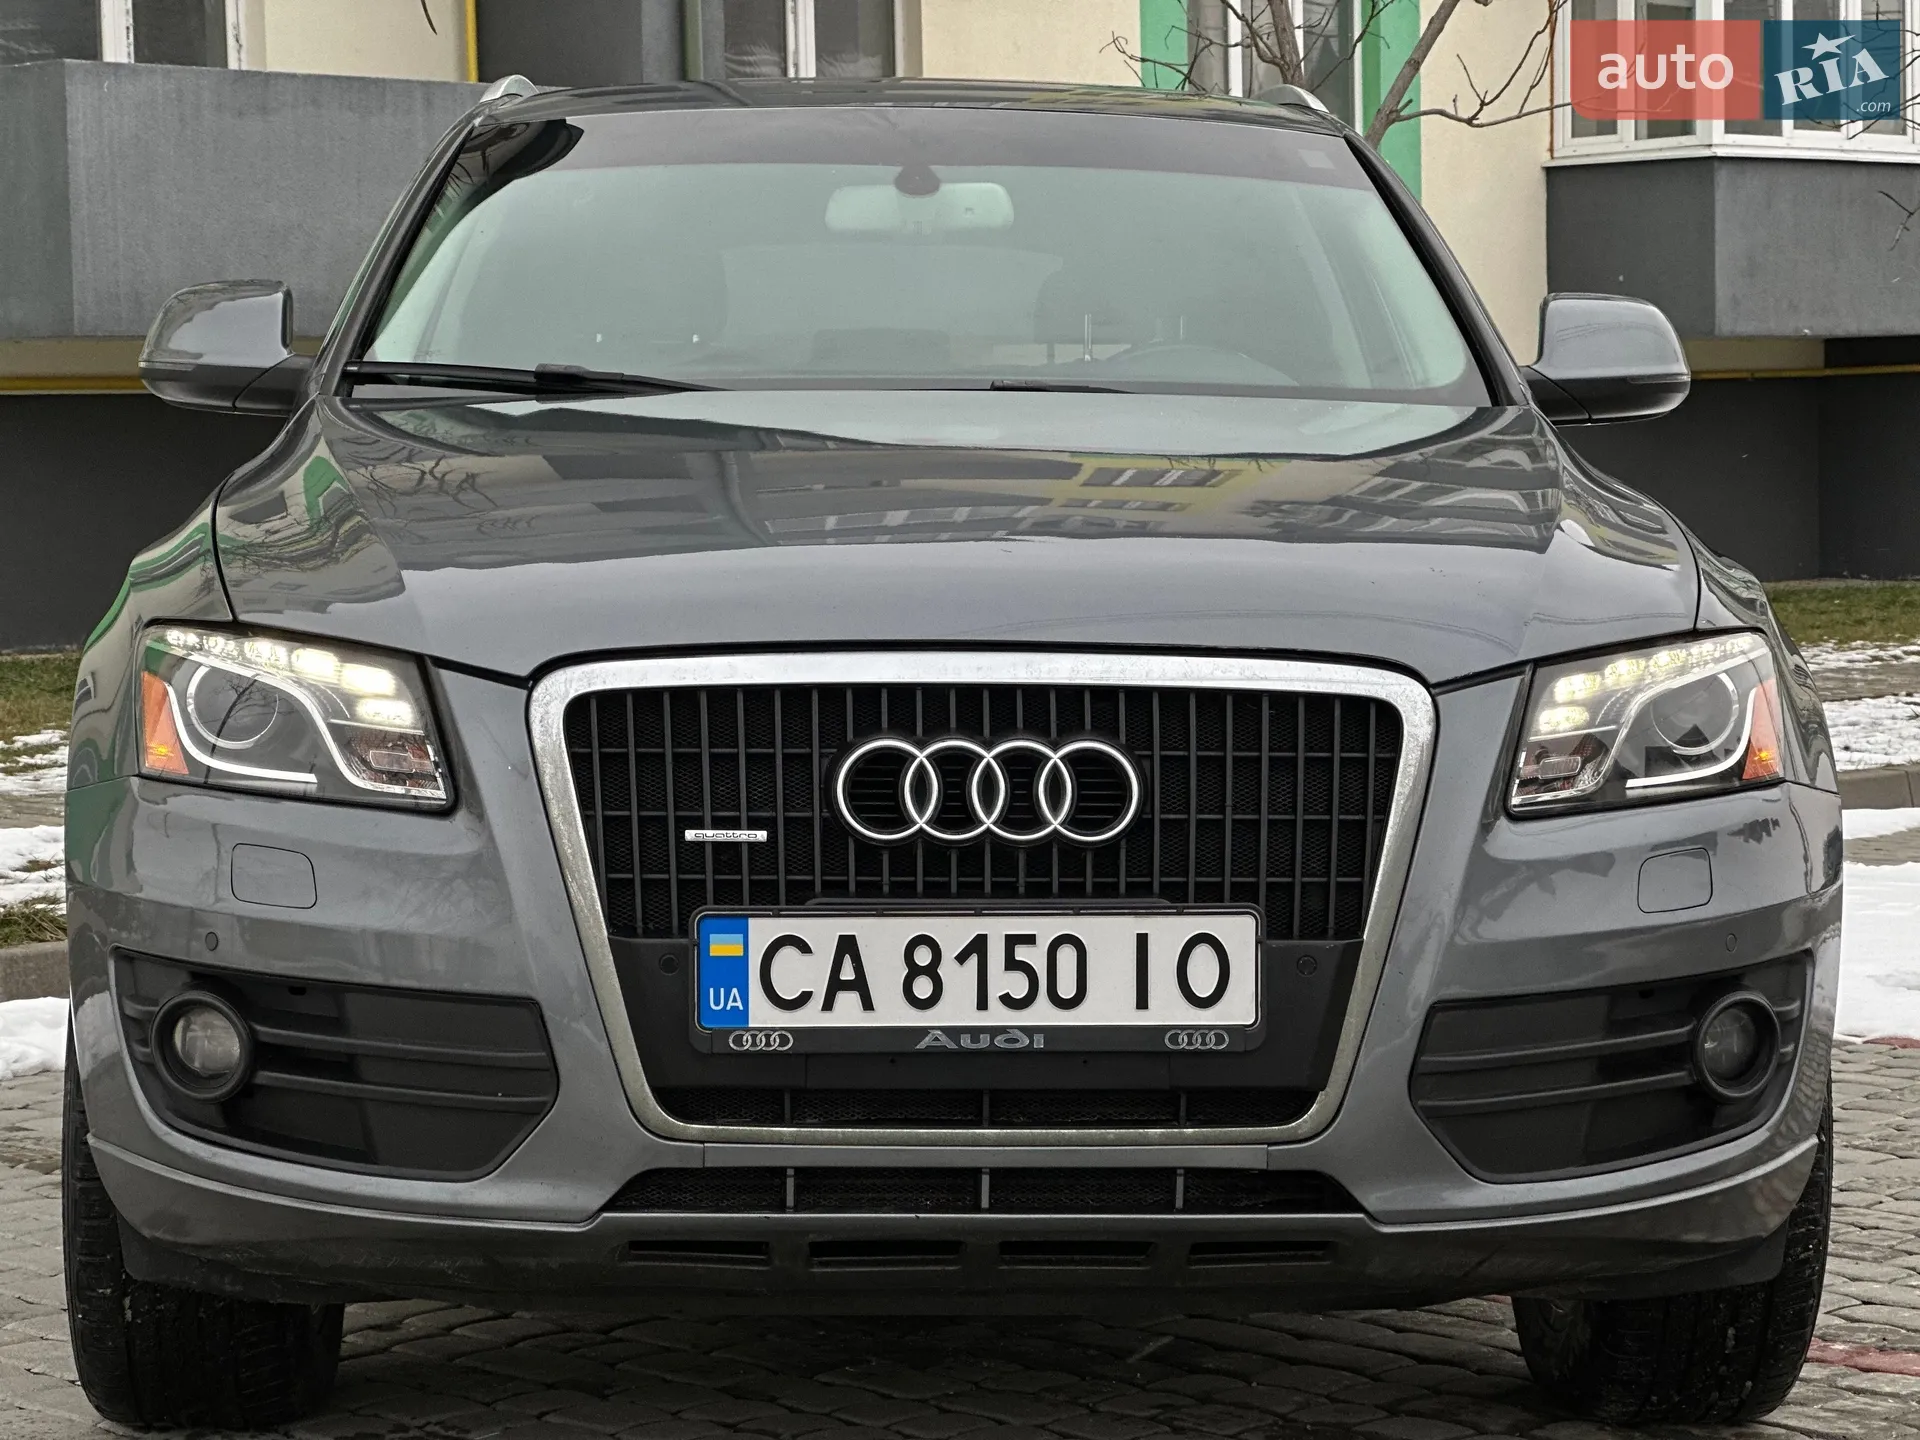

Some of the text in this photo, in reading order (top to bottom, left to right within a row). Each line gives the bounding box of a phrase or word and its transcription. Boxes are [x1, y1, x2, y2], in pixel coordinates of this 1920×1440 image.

[759, 933, 875, 1013] CA
[901, 932, 1088, 1012] 8150
[709, 988, 744, 1011] UA
[914, 1029, 1045, 1050] Audi
